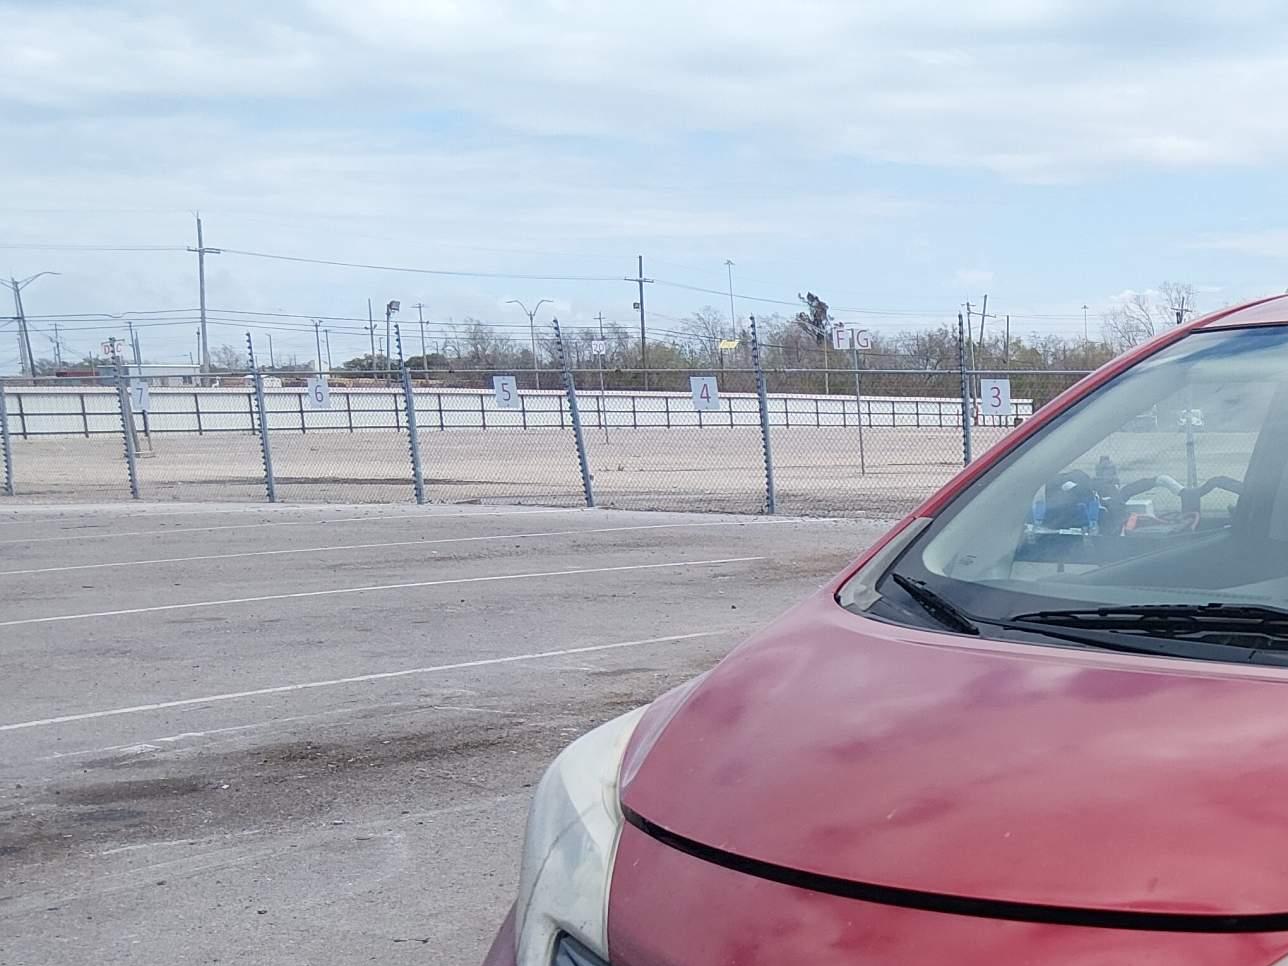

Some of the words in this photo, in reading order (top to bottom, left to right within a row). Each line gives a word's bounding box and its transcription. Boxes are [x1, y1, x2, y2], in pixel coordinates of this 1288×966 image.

[836, 329, 845, 349] F
[856, 329, 870, 348] G
[135, 387, 144, 404] 7
[314, 384, 324, 402] 6
[501, 382, 511, 401] 5
[700, 383, 712, 403] 4
[989, 386, 1002, 408] 3
